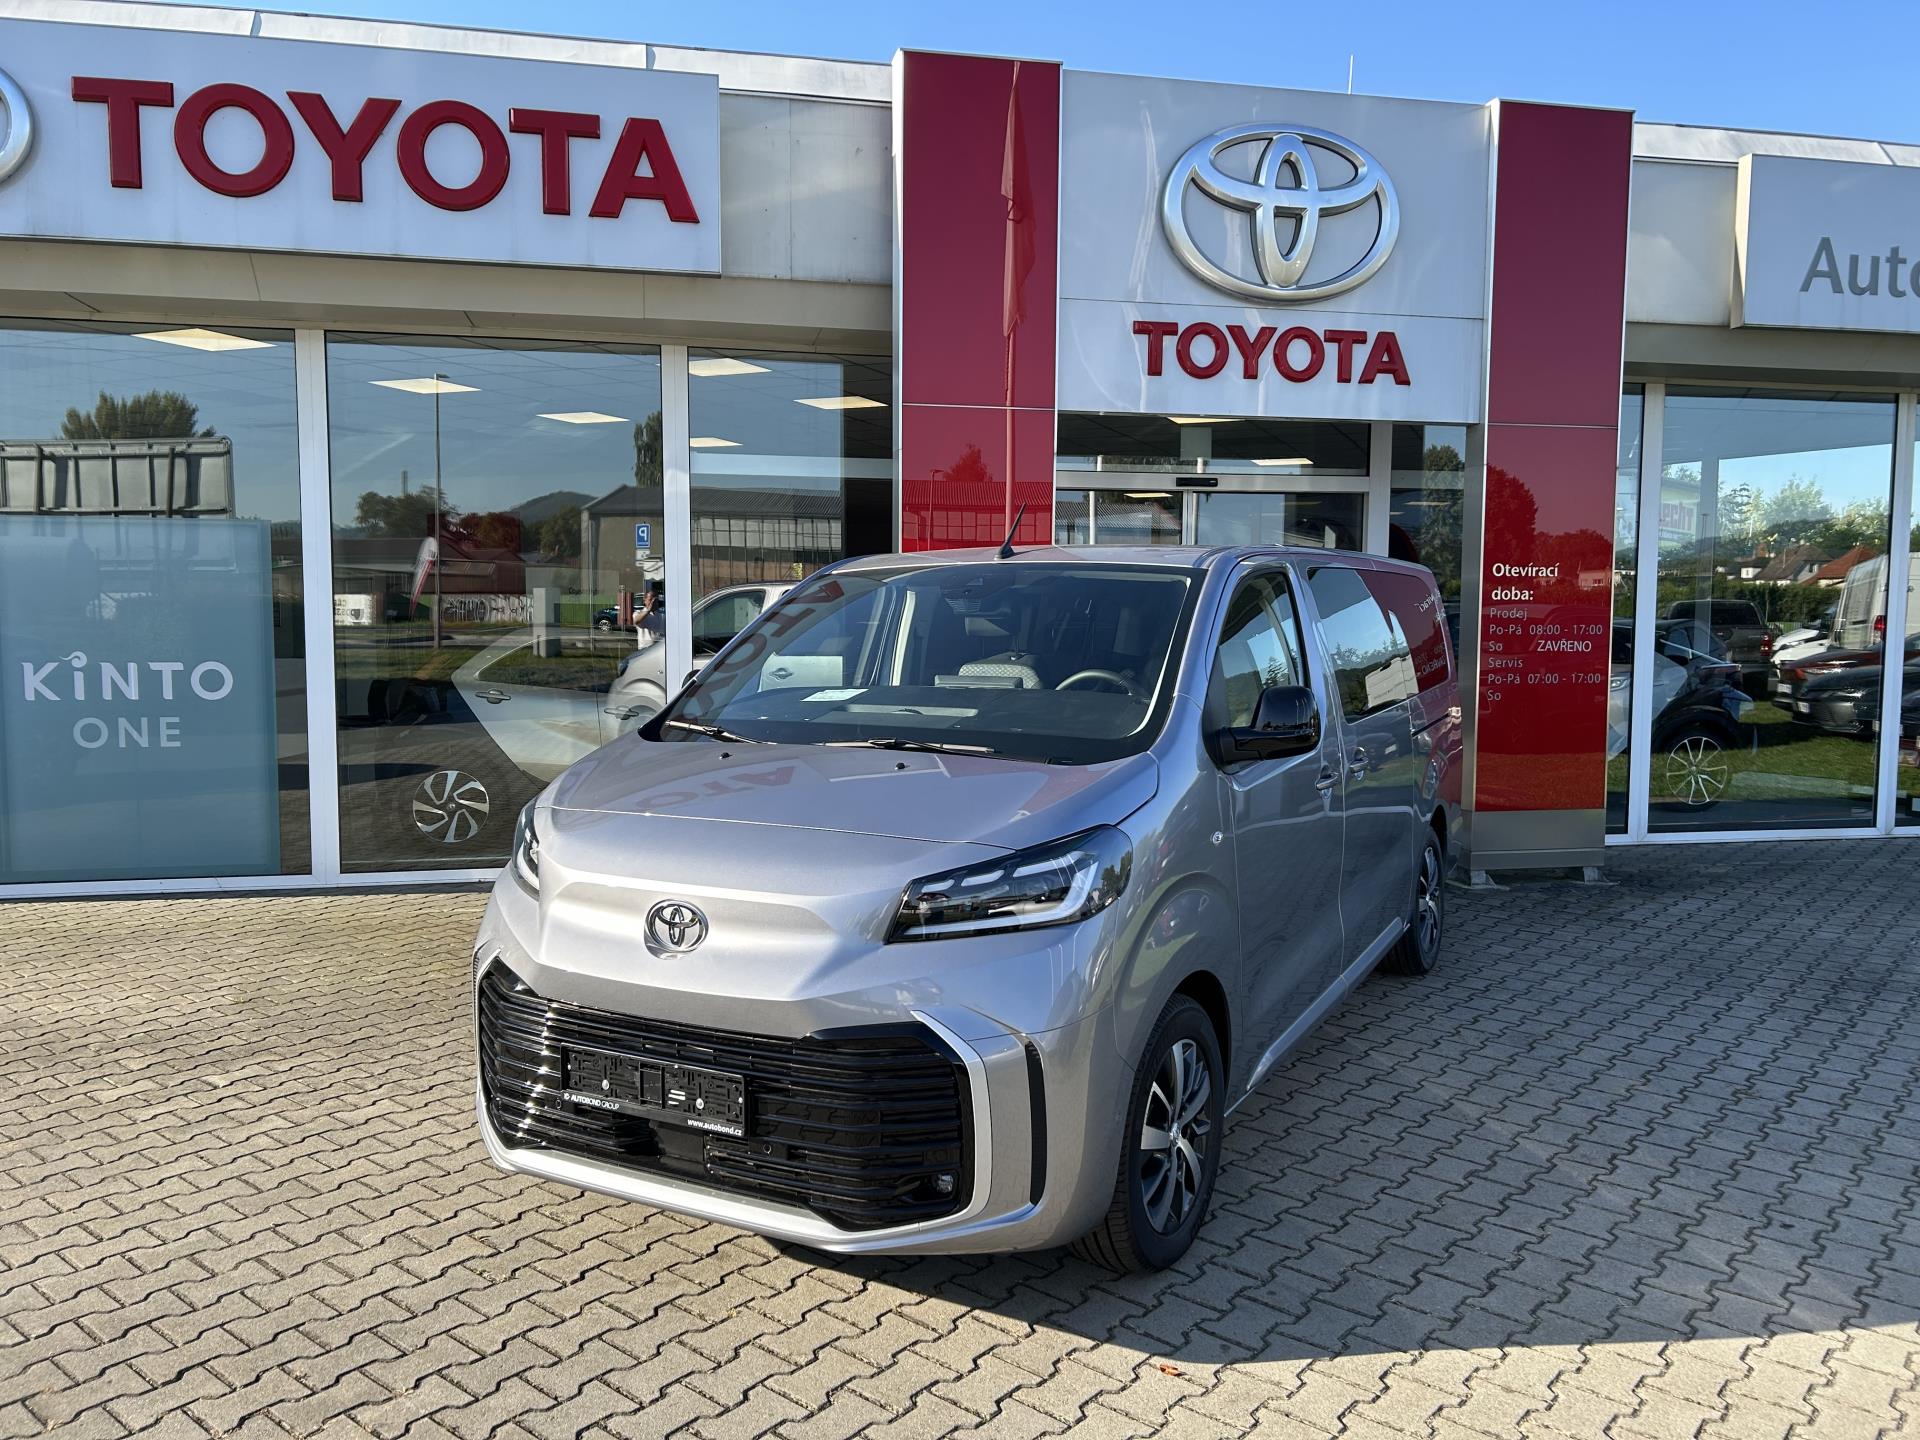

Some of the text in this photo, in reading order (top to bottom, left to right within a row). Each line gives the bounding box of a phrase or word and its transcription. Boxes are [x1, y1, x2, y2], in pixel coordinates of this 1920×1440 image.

[71, 76, 700, 224] TOYOTA
[1133, 321, 1411, 386] TOYOTA
[1492, 562, 1560, 577] Otevírací
[1491, 586, 1534, 600] doba:
[1490, 607, 1528, 621] Prodej
[1489, 624, 1522, 635] Po-Pá
[1529, 624, 1560, 635] 08:00
[1573, 624, 1603, 635] 17:00
[1488, 638, 1592, 652] So ZAVŘENO
[1488, 657, 1523, 668] Servis
[1487, 673, 1521, 684] Po-Pá
[1527, 673, 1559, 684] 07:00
[1571, 673, 1601, 684] 17:00
[1487, 689, 1501, 701] So
[72, 716, 182, 749] ONE
[570, 1094, 620, 1110] AUTOBOND GROUP
[687, 1119, 742, 1136] www.autobond.cz
